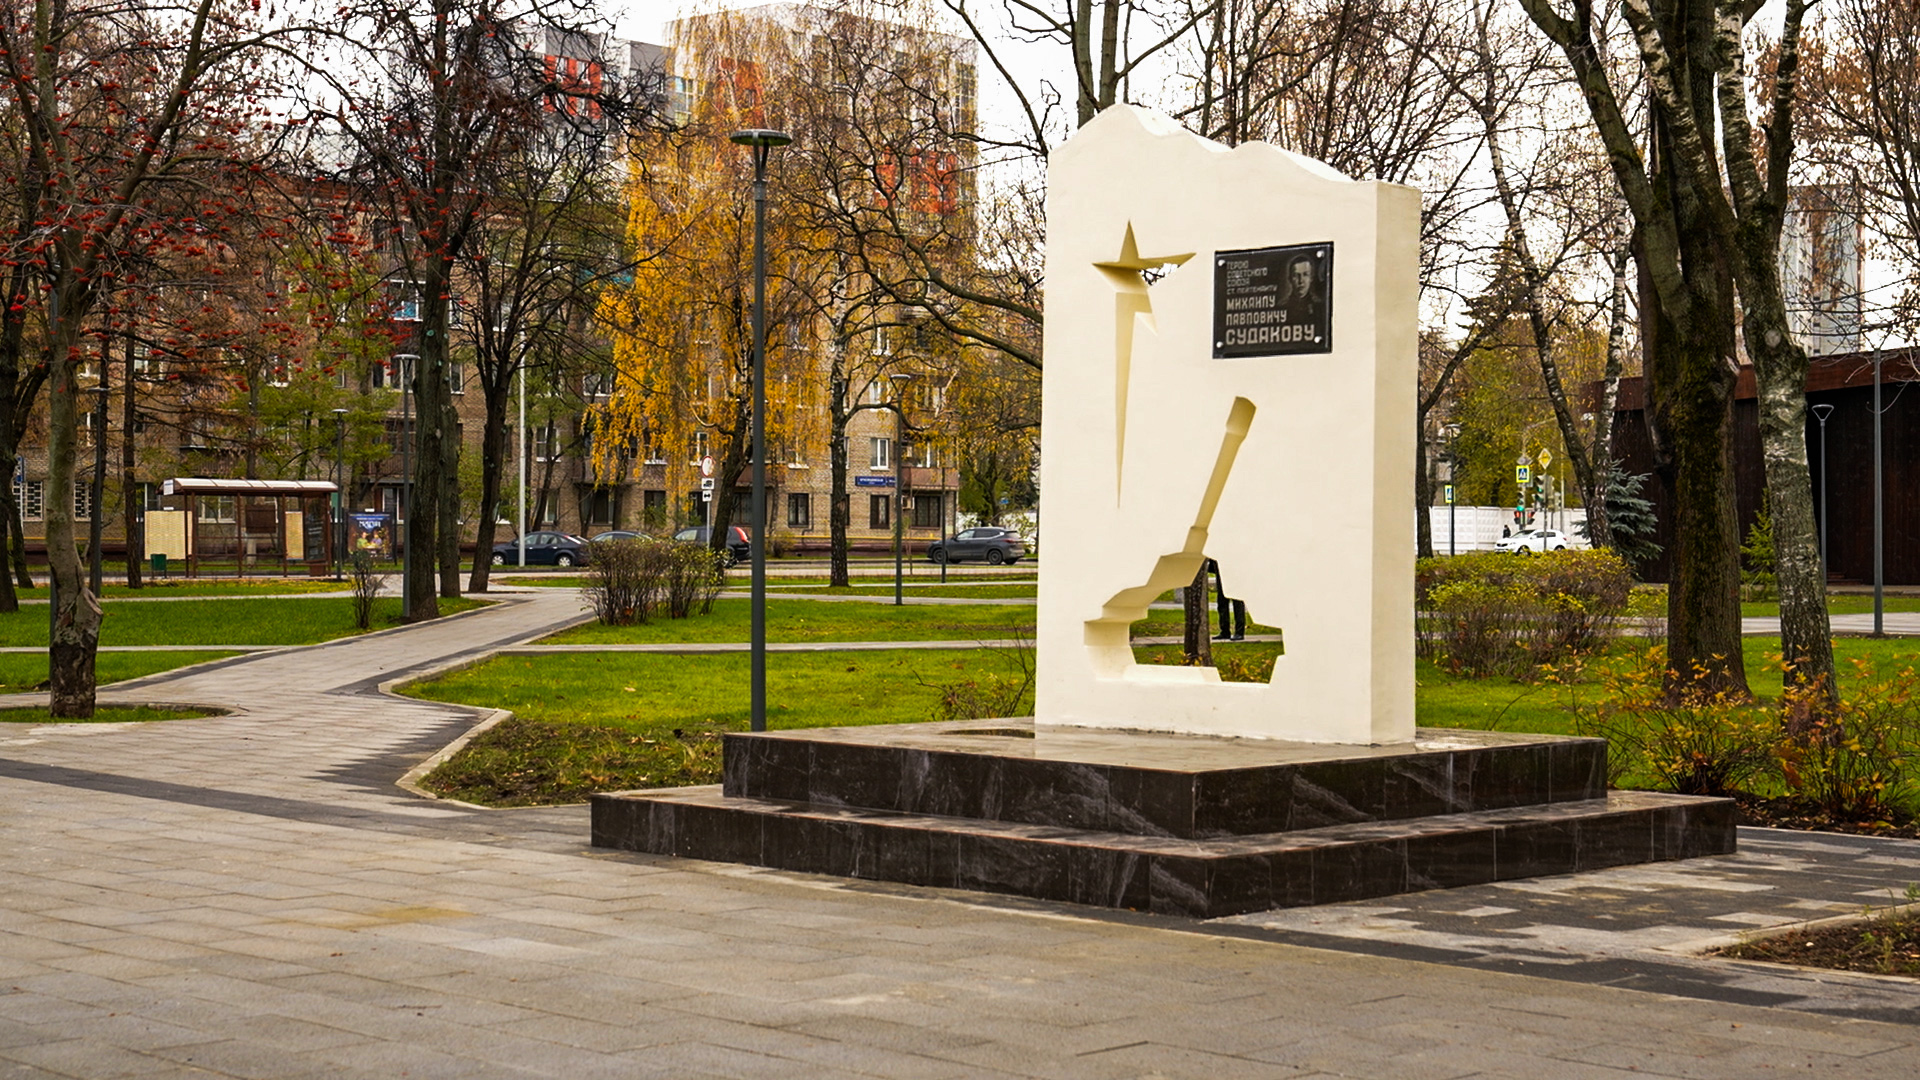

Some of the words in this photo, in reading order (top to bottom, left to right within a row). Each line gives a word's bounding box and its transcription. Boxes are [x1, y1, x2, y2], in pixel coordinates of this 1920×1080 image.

[1226, 295, 1276, 311] МИХАИЛУ
[1226, 310, 1287, 326] ПАВЛОВИЧУ
[1226, 324, 1315, 346] СУДАКОВУ
